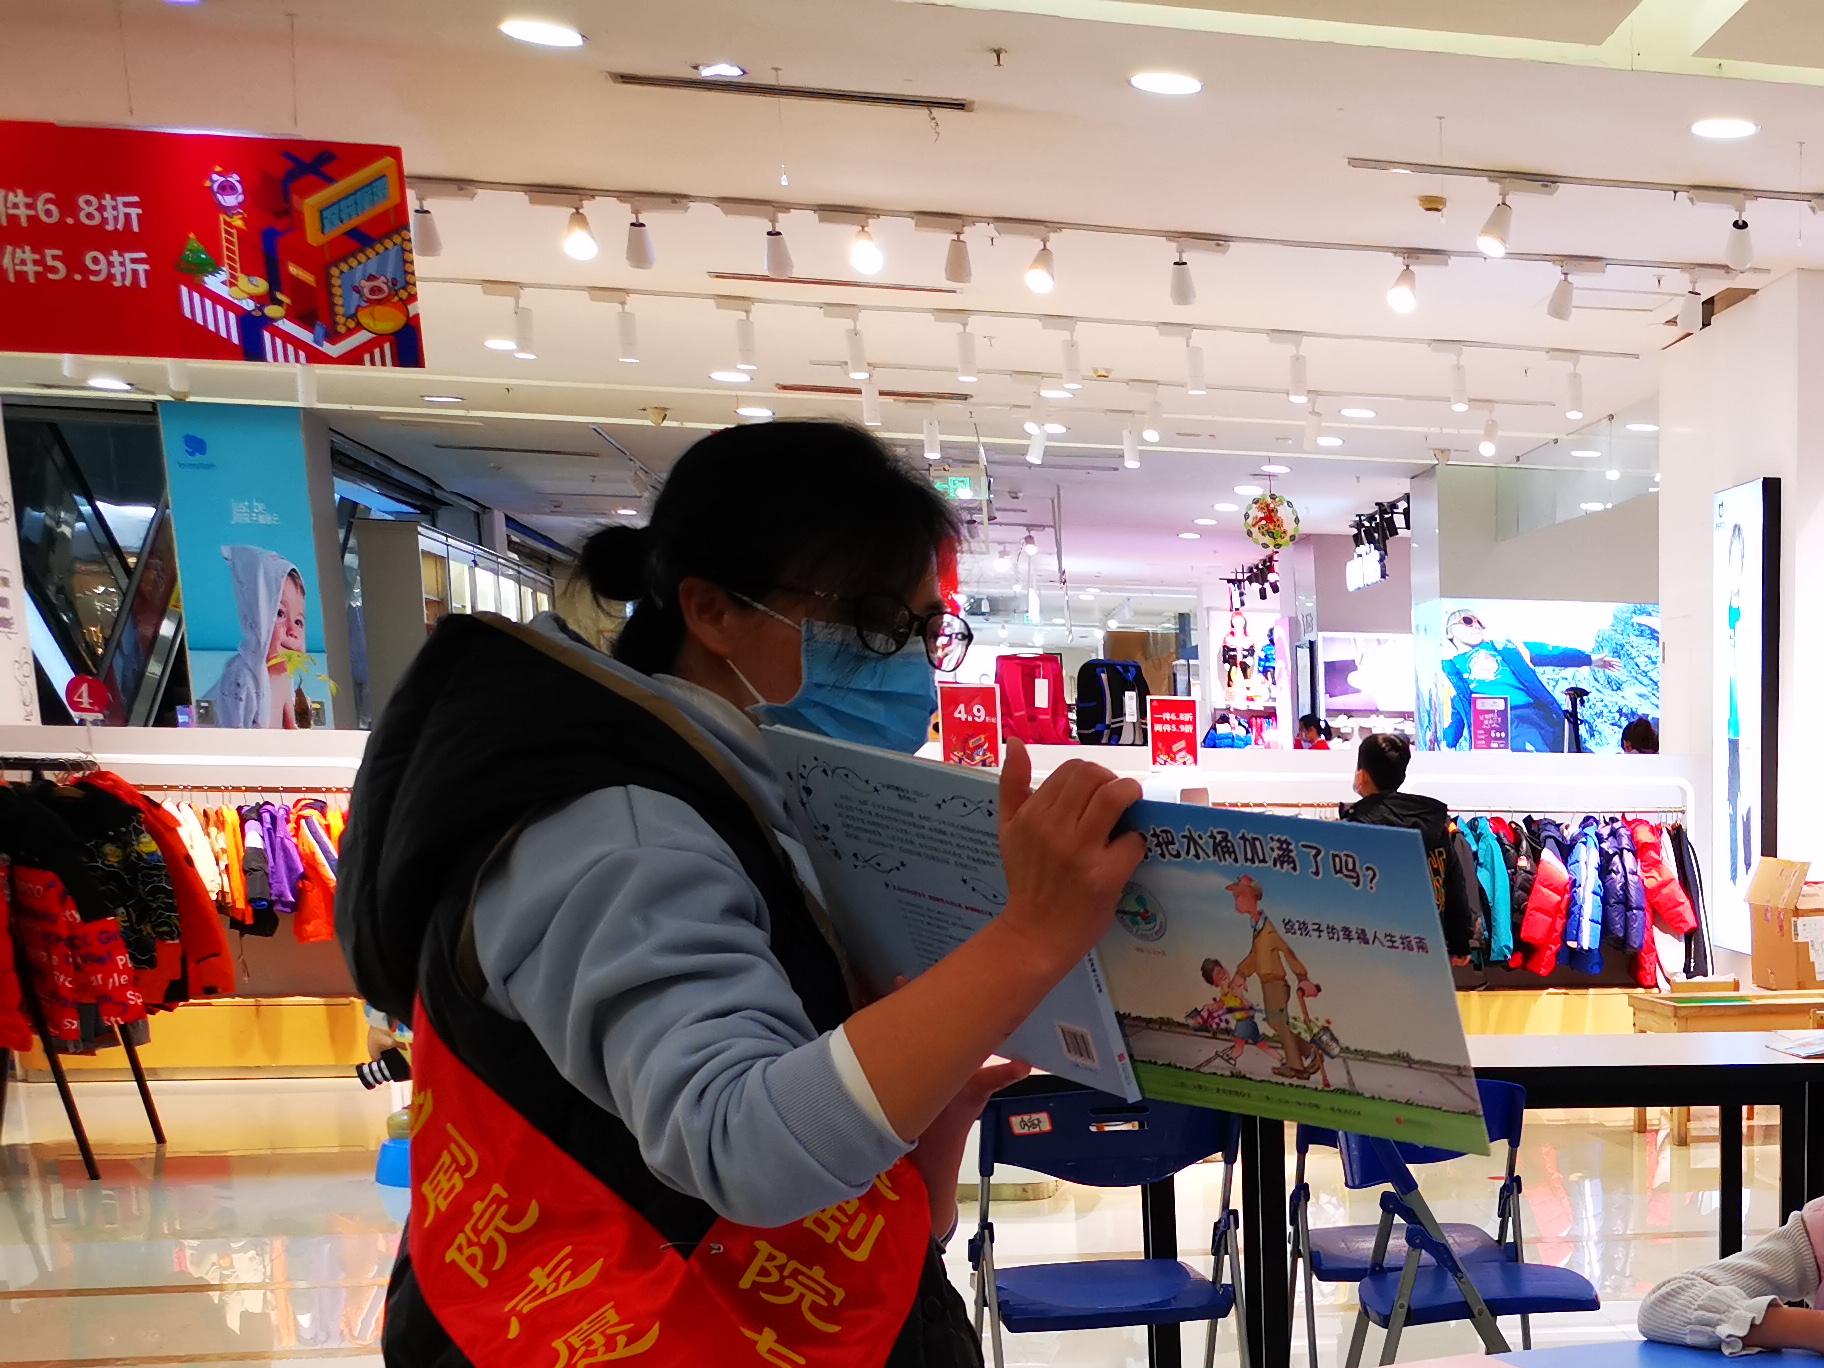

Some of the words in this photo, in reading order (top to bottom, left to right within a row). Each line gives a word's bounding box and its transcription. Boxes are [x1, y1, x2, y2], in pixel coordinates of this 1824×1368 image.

[73, 682, 94, 709] 4
[1143, 825, 1380, 892] 把水桶加满了吗？
[1281, 917, 1430, 954] 给孩子的幸福人生指南
